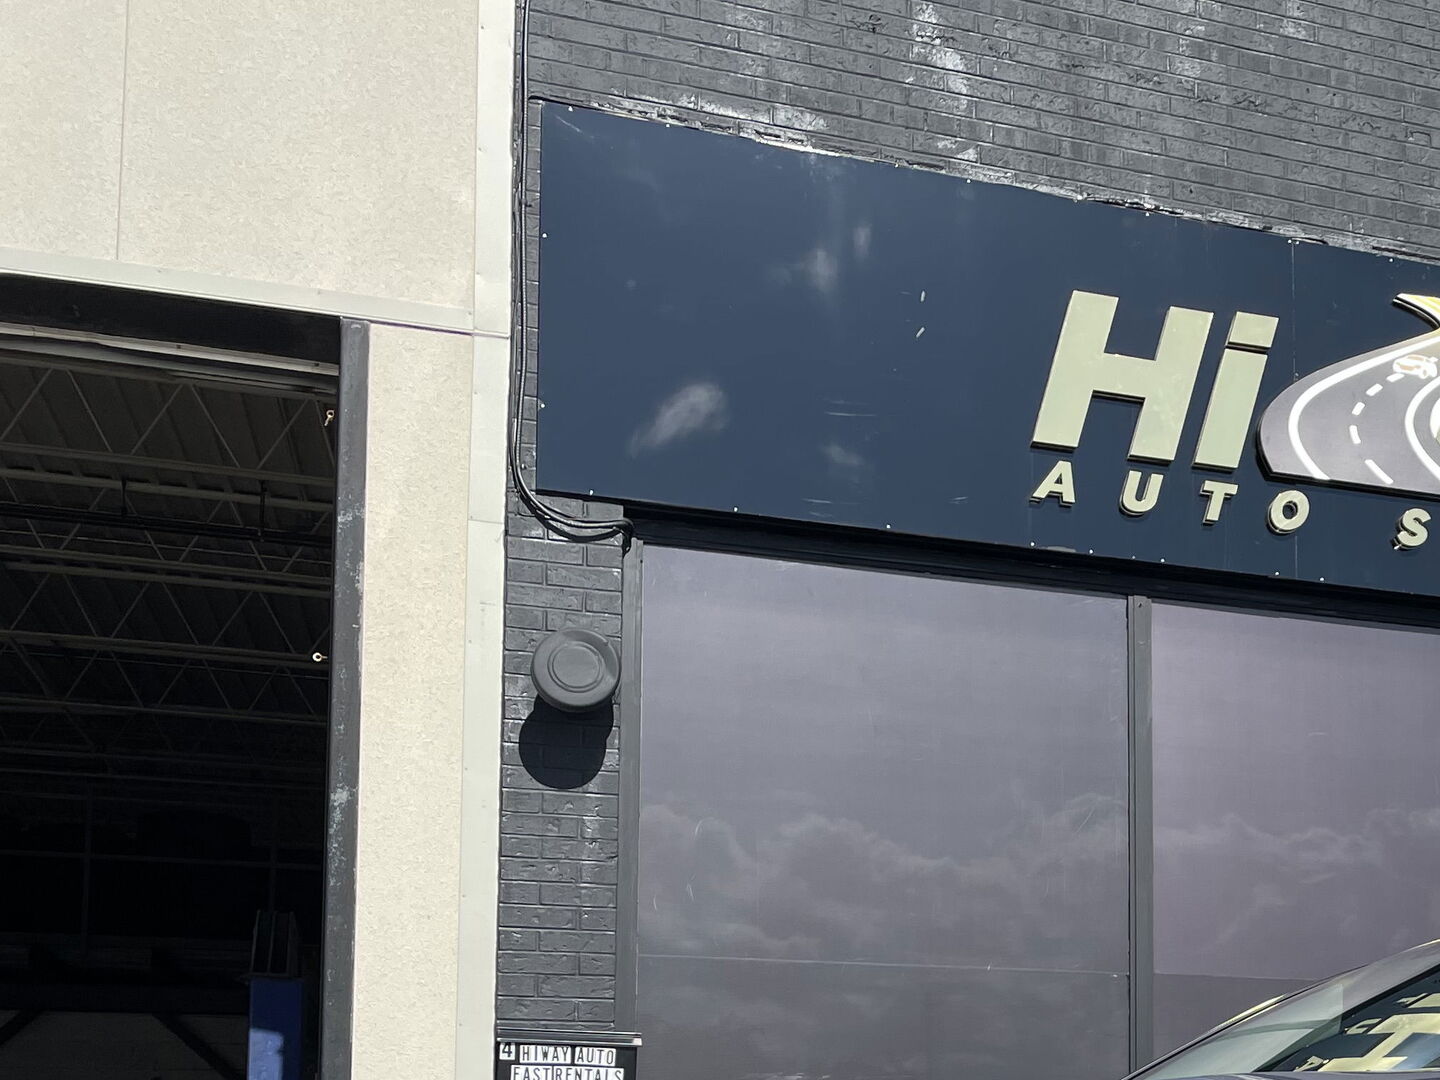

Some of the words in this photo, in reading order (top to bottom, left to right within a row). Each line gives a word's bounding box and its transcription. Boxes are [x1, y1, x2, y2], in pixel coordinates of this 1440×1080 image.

[1030, 460, 1310, 535] AUTO
[502, 1043, 512, 1058] 4
[522, 1045, 569, 1063] HIWAY
[577, 1048, 614, 1065] AUTO
